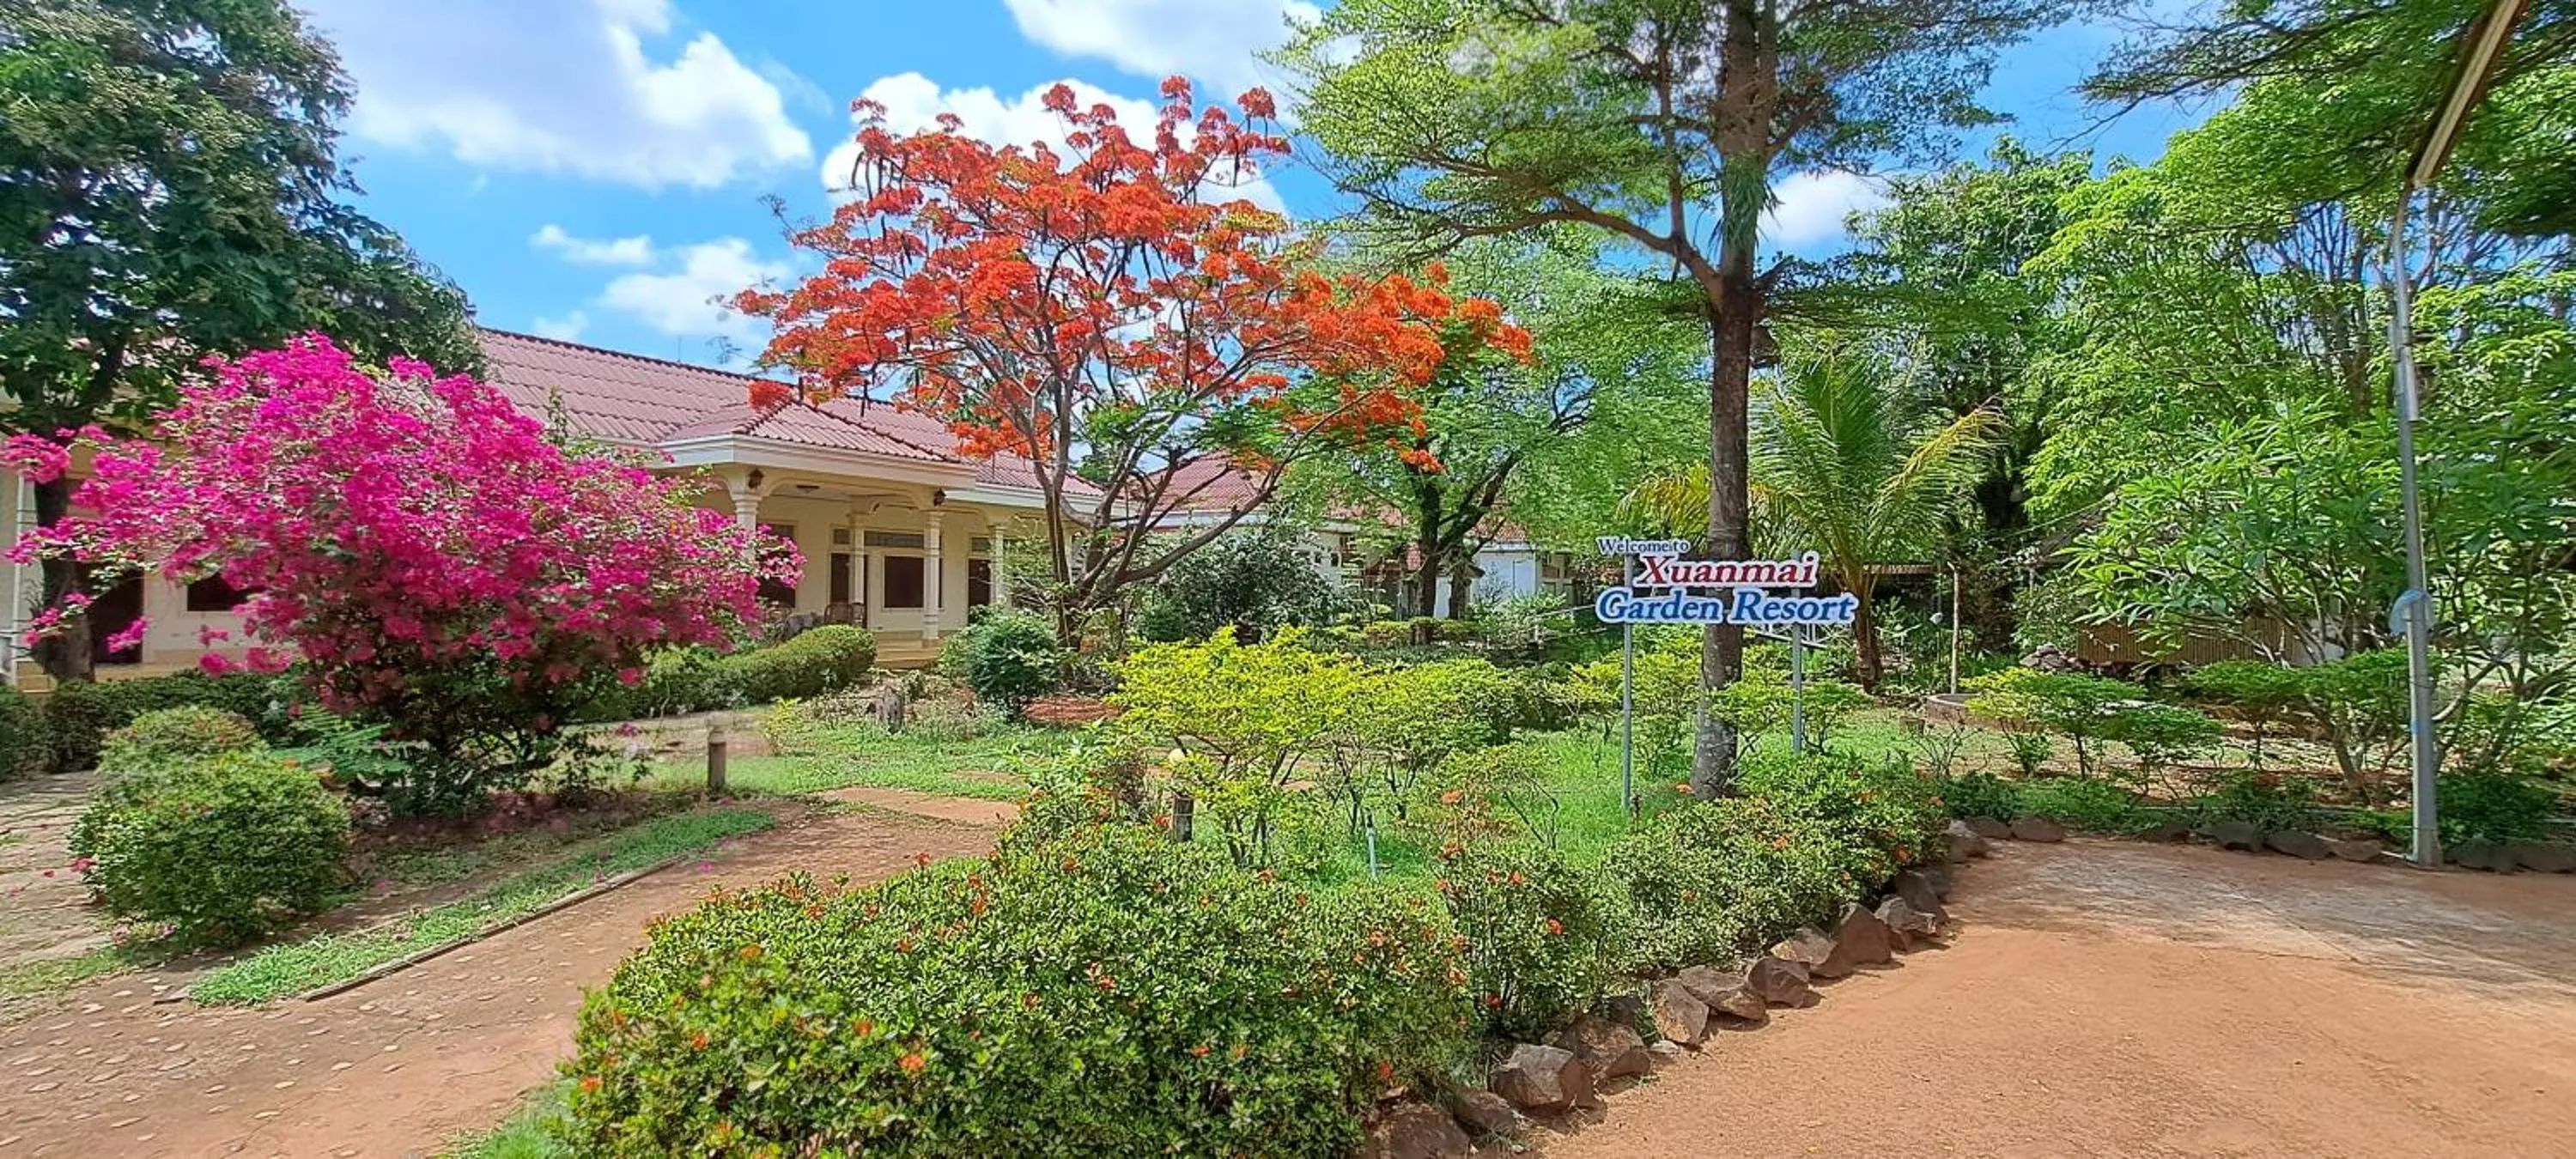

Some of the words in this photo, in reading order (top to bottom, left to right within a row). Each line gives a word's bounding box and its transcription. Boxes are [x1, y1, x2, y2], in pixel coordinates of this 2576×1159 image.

[1597, 537, 1669, 553] Welcome
[1672, 538, 1689, 552] to
[1637, 555, 1814, 584] Xuanmai
[1599, 590, 1721, 621] Garden
[1731, 590, 1856, 621] Resort
